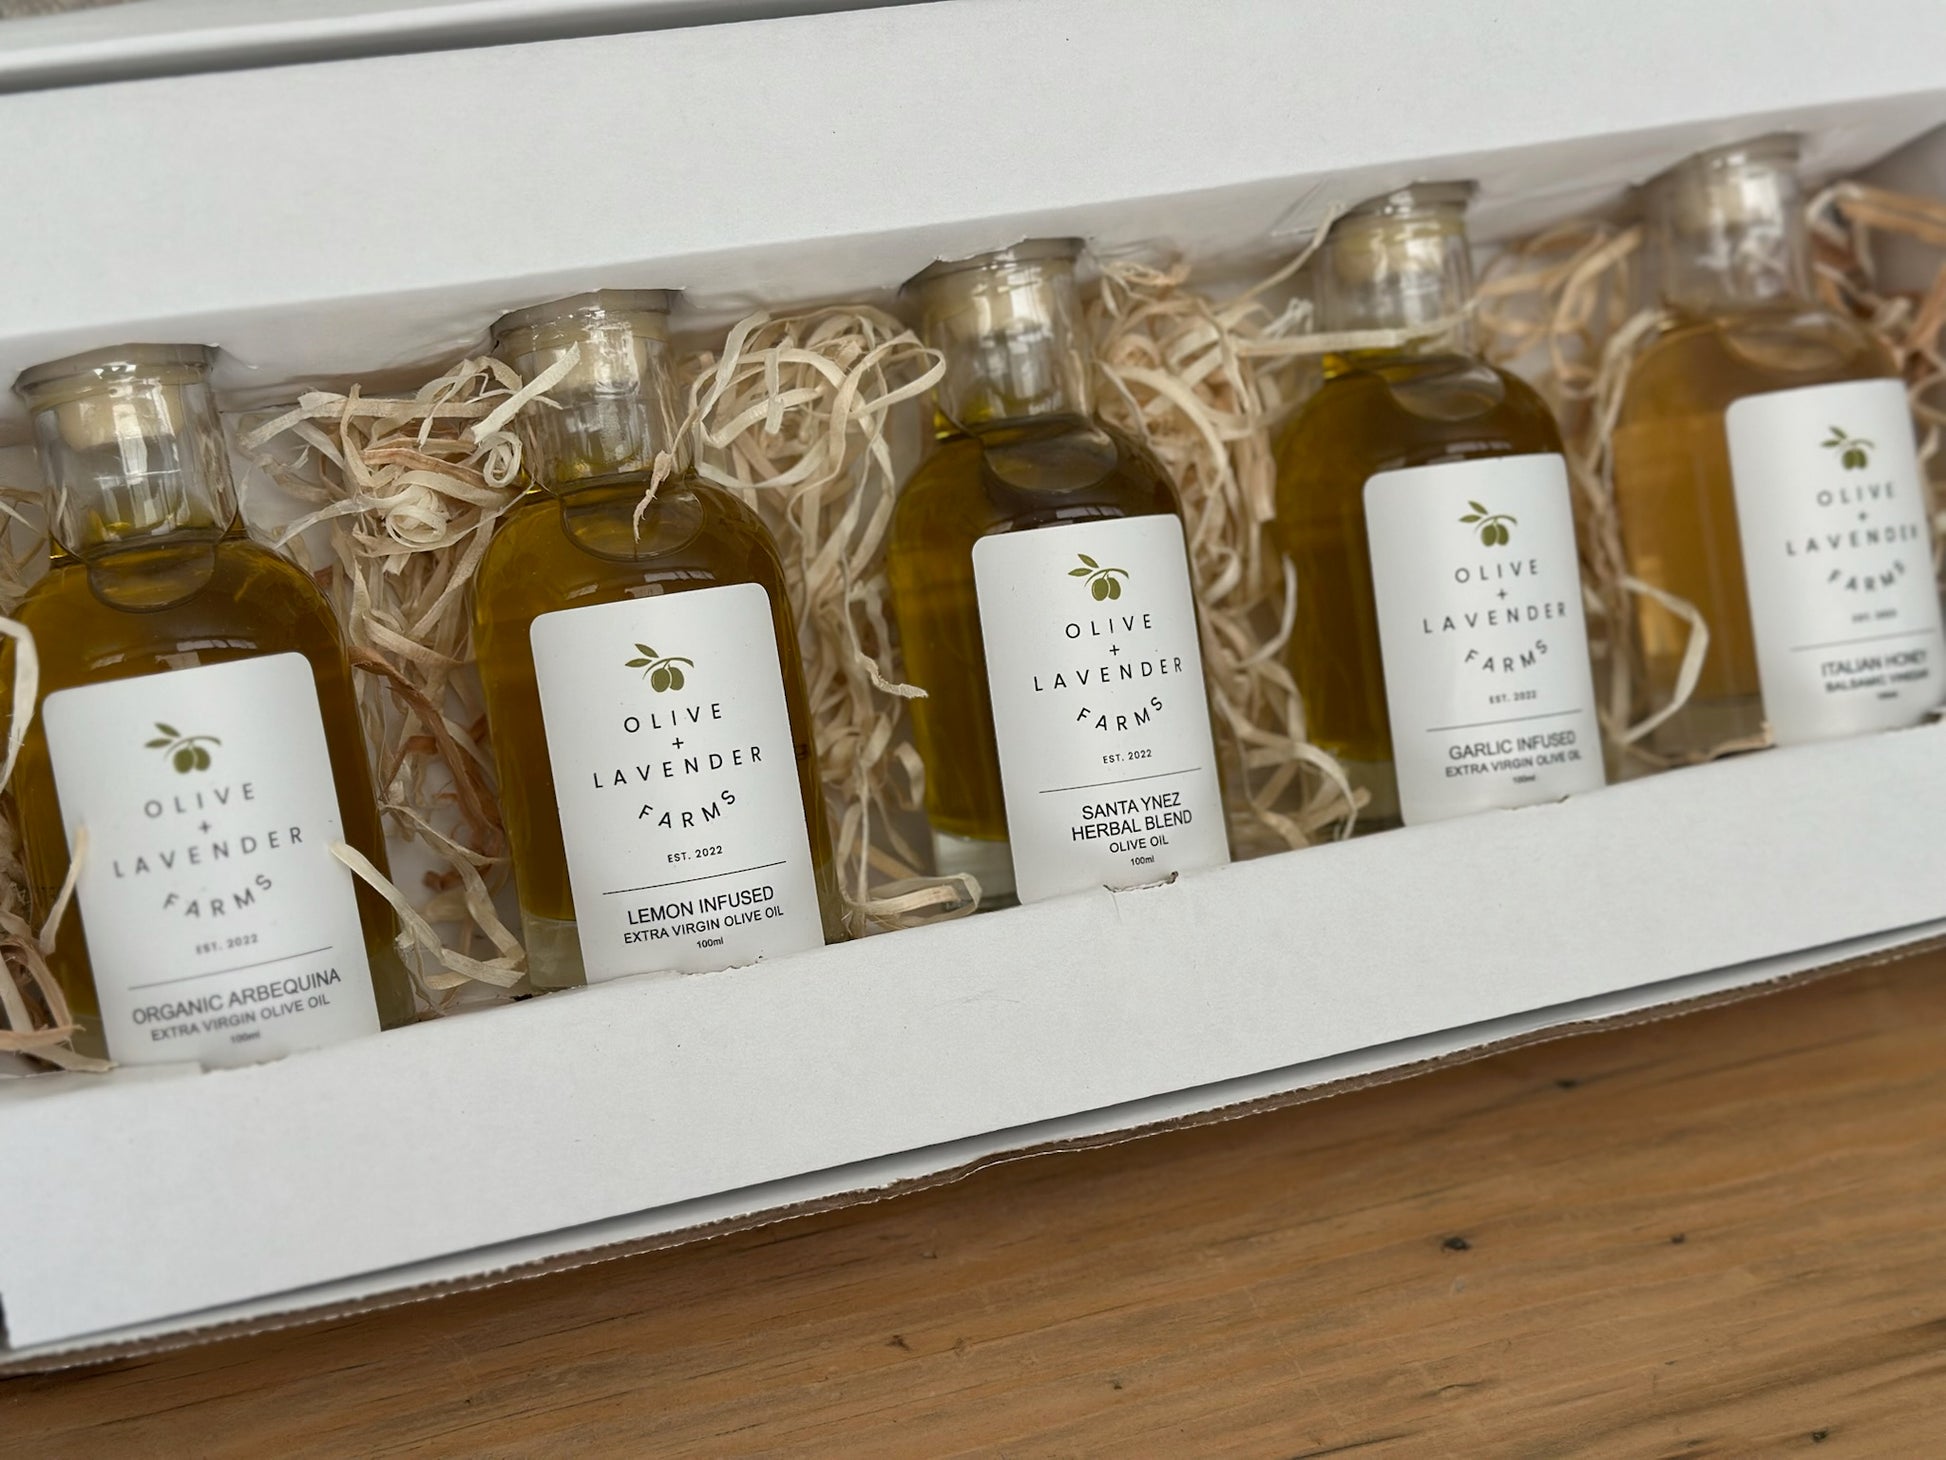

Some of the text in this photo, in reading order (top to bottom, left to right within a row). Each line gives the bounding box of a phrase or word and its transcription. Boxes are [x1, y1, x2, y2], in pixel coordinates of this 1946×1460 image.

[1815, 481, 1896, 508] OLIVE
[1454, 558, 1538, 584] OLIVE
[1828, 560, 1905, 592] FARMS
[1496, 588, 1508, 600] +
[1066, 614, 1152, 639] OLIVE
[1422, 601, 1567, 635] LAVENDER
[1109, 645, 1121, 656] +
[1464, 639, 1548, 673] FARMS
[1034, 658, 1182, 692] LAVENDER
[1821, 657, 1883, 677] ITALIAN
[1488, 692, 1511, 706] EST.
[624, 703, 722, 734] OLIVE
[1077, 697, 1163, 732] FARMS
[672, 738, 685, 750] +
[1103, 749, 1152, 764] EST. 2022
[1448, 729, 1576, 761] GARLIC INFUSED
[594, 747, 762, 789] LAVENDER
[1445, 762, 1489, 778] EXTRA
[1490, 757, 1534, 772] VIRGIN
[1536, 751, 1567, 766] OLIVE
[143, 782, 255, 819] OLIVE
[639, 790, 736, 829] FARMS
[1082, 792, 1182, 821] SANTA YNEZ
[198, 820, 213, 834] +
[1072, 810, 1193, 842] HERBAL BLEND
[113, 826, 303, 878] LAVENDER
[668, 846, 723, 864] EST. 2022
[1110, 835, 1169, 854] OLIVE OIL
[1131, 855, 1155, 866] 100ml
[163, 874, 273, 918] FARMS
[628, 886, 774, 926] LEMON INFUSED
[624, 906, 784, 944] EXTRA VIRGIN OLIVE OIL
[195, 933, 259, 956] EST. 2022
[697, 937, 724, 949] 100ml
[132, 967, 342, 1025] ORGANIC ARBEQUINA
[150, 993, 331, 1042] EXTRA VIRGIN OLIVE OIL
